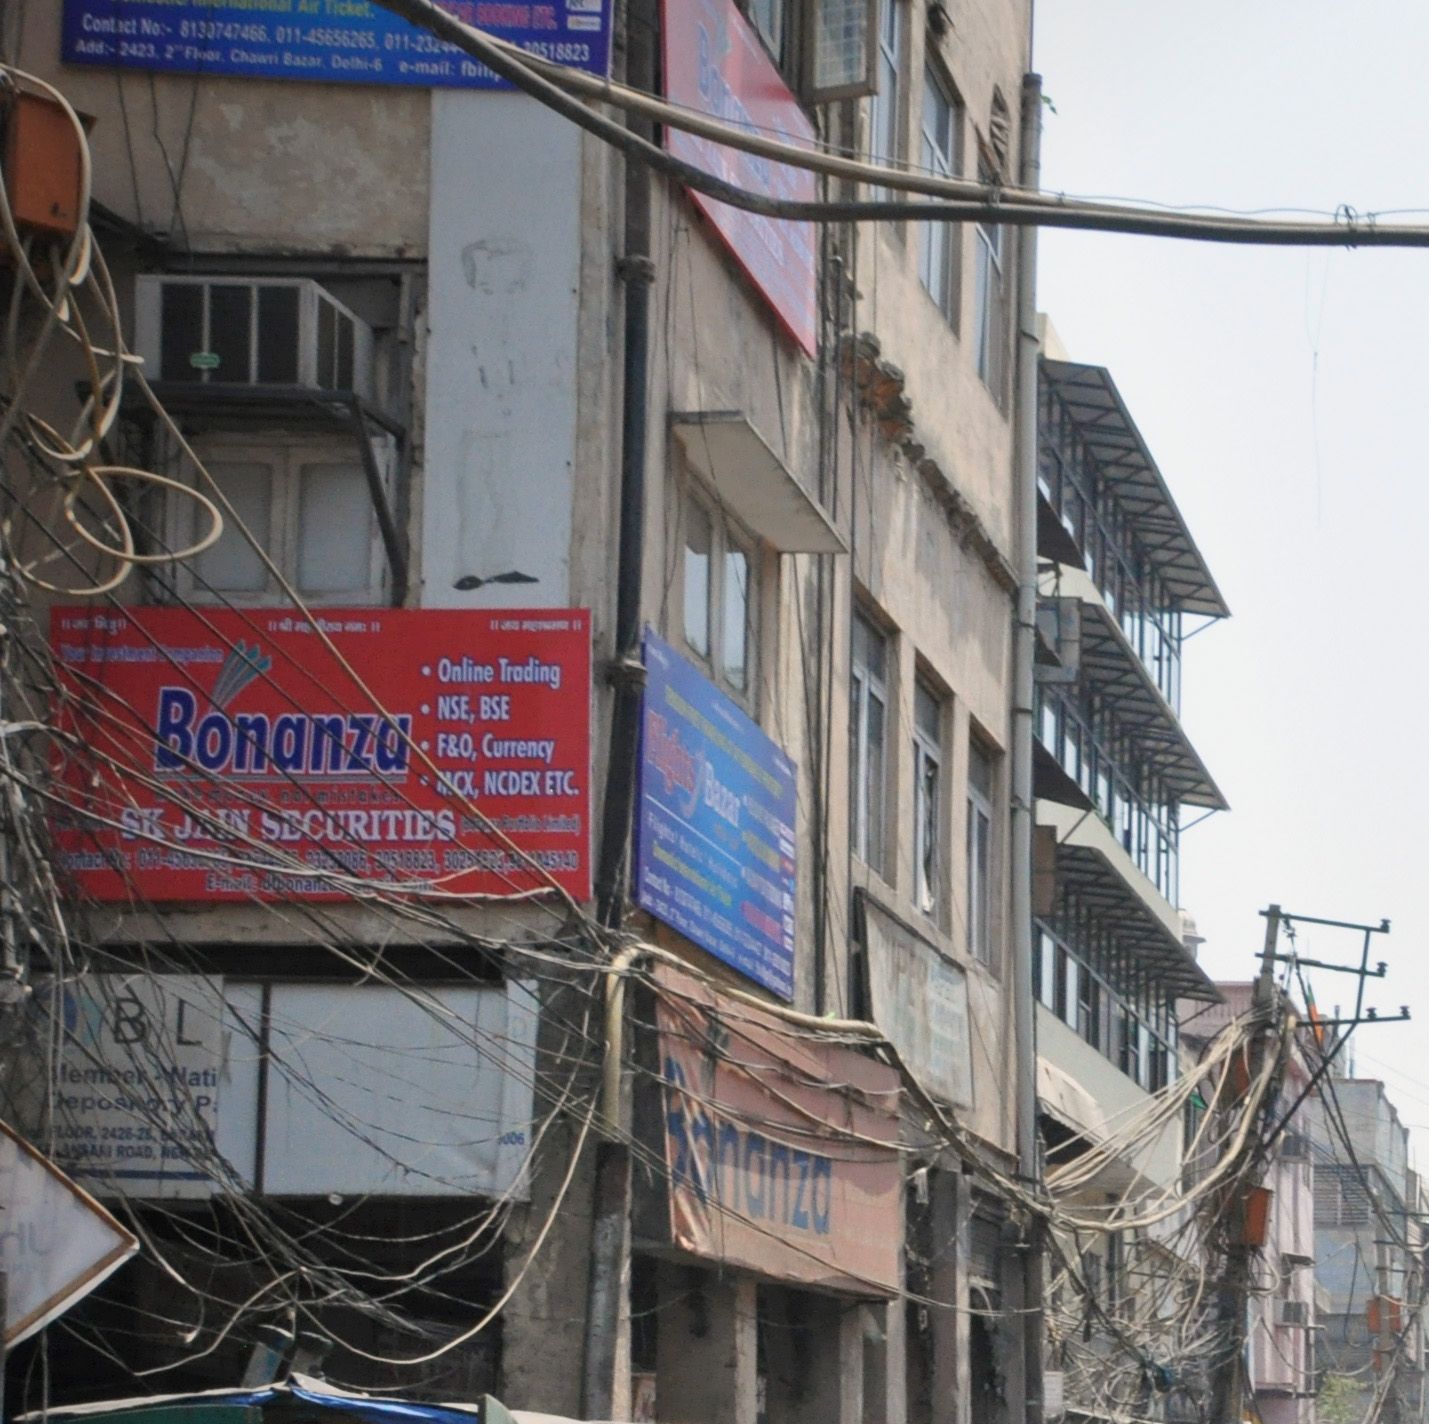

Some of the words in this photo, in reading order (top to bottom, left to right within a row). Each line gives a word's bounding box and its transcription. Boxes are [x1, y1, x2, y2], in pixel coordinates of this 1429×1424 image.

[83, 13, 137, 34] Contact
[437, 656, 494, 683] Online
[499, 656, 562, 690] Trading
[437, 696, 475, 724] NSE,
[480, 696, 511, 721] BSE
[154, 686, 412, 774] Bonanza
[437, 732, 476, 761] F&O,
[482, 732, 555, 764] Currency
[484, 771, 540, 796] NCDEX
[545, 771, 580, 796] ETC.
[121, 807, 165, 841] SK
[260, 808, 456, 843] SECURITIES
